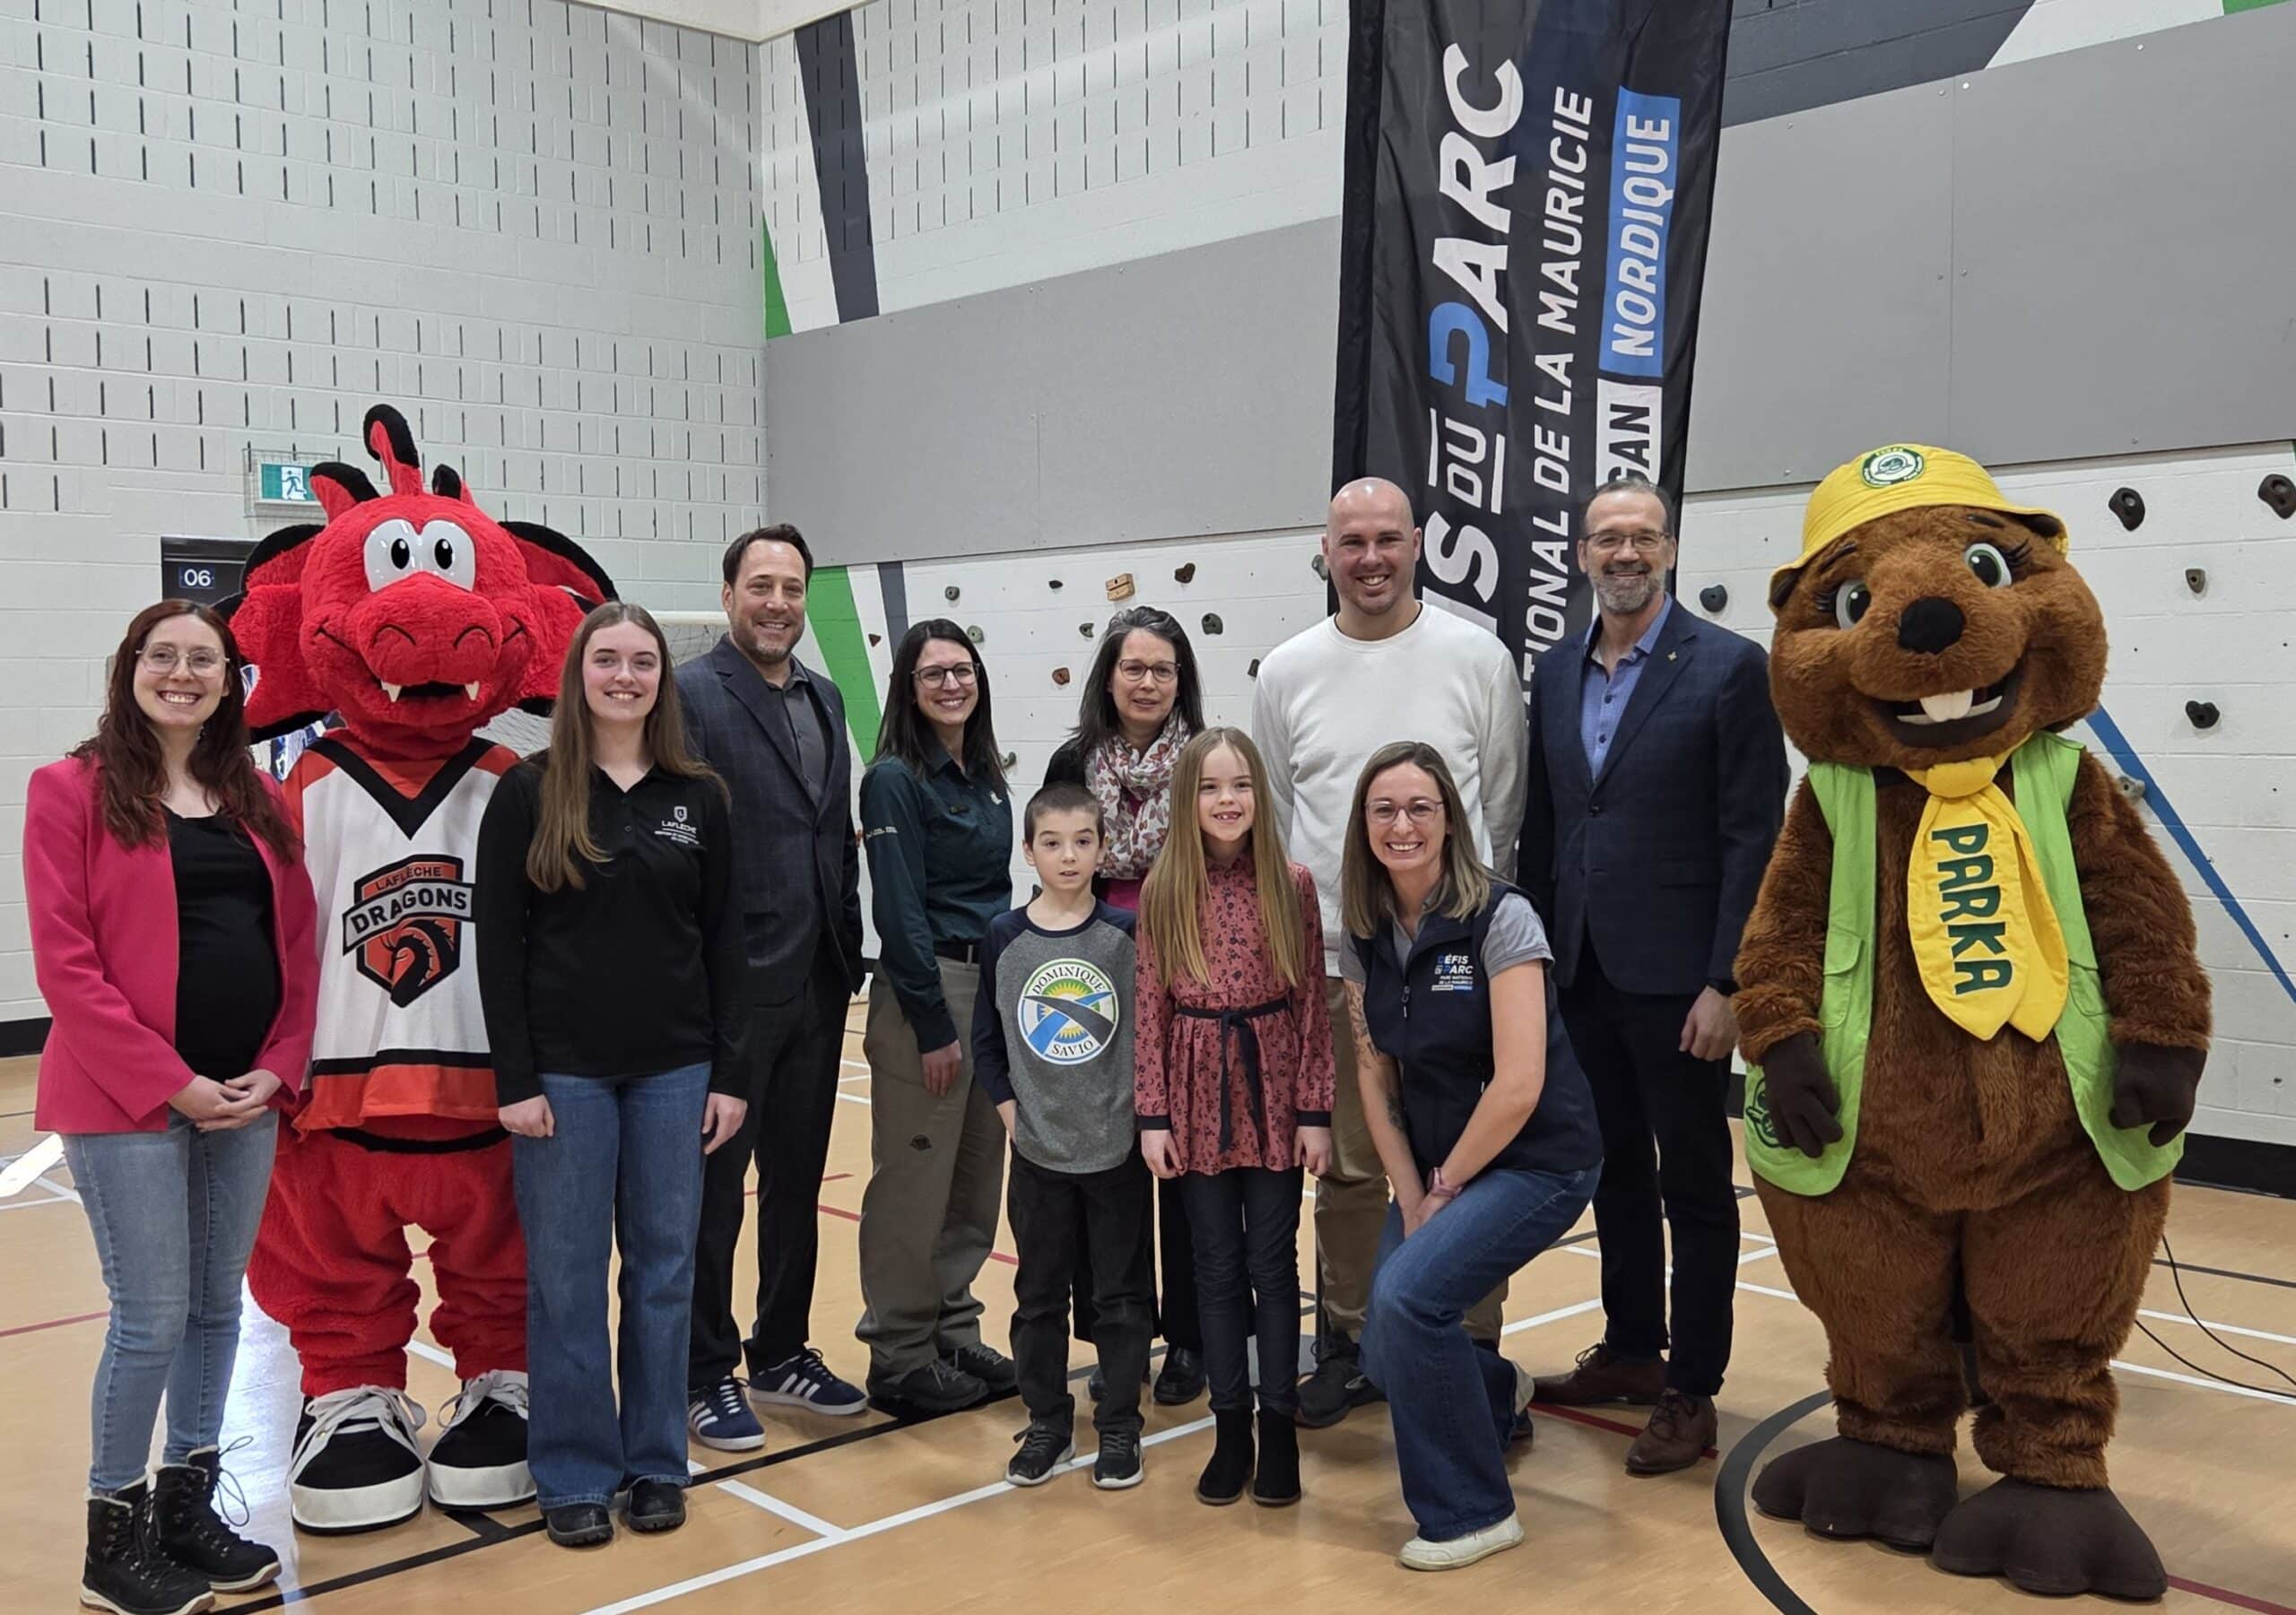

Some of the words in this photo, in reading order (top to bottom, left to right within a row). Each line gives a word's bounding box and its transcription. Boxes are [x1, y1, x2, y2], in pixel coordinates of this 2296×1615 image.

[1429, 43, 1524, 408] PARC
[1537, 87, 1592, 334] MAURICIE
[1612, 115, 1674, 356] NORDIQUE
[1535, 353, 1573, 415] LA
[1445, 417, 1486, 508] DU
[1535, 424, 1570, 494] DE
[184, 569, 212, 586] 06
[350, 888, 467, 934] DRAGONS
[1932, 823, 2013, 995] PARKA
[1032, 967, 1105, 995] DOMINIQUE
[1051, 1040, 1094, 1056] SAVIO
